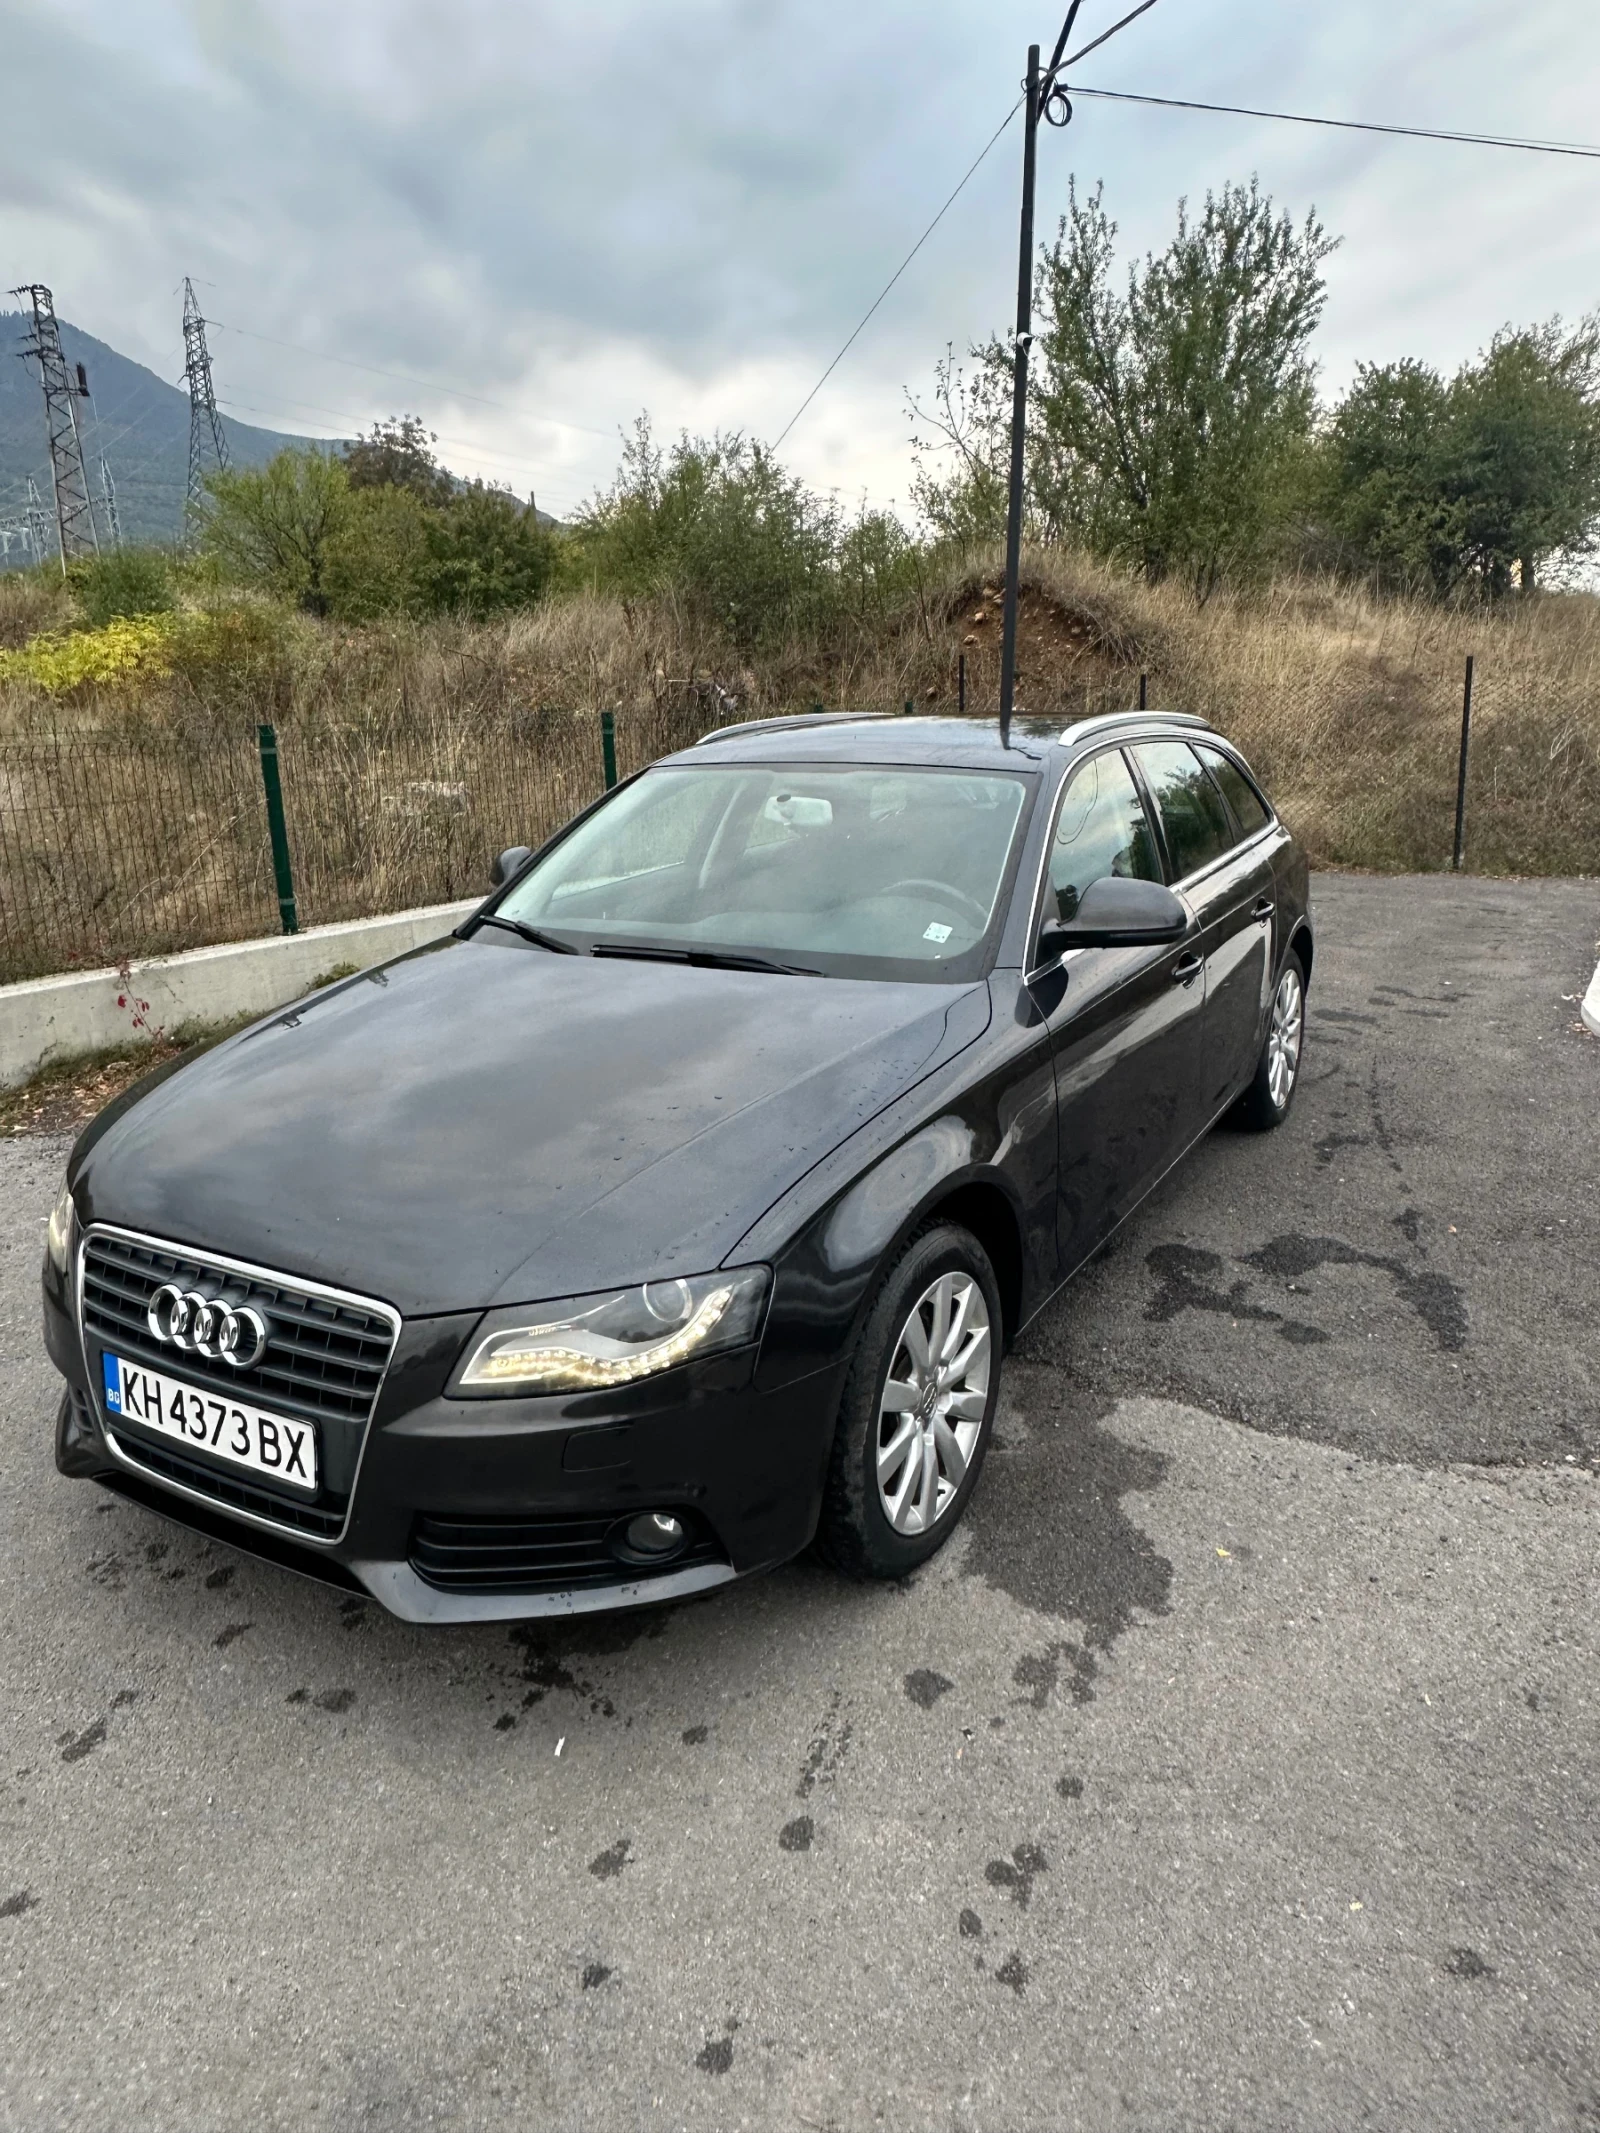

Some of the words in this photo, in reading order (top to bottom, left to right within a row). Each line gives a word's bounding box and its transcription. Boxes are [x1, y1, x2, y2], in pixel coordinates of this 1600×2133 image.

[108, 1388, 120, 1404] BG
[123, 1367, 163, 1425] KH
[170, 1390, 250, 1456] 4373
[258, 1417, 307, 1478] BX
